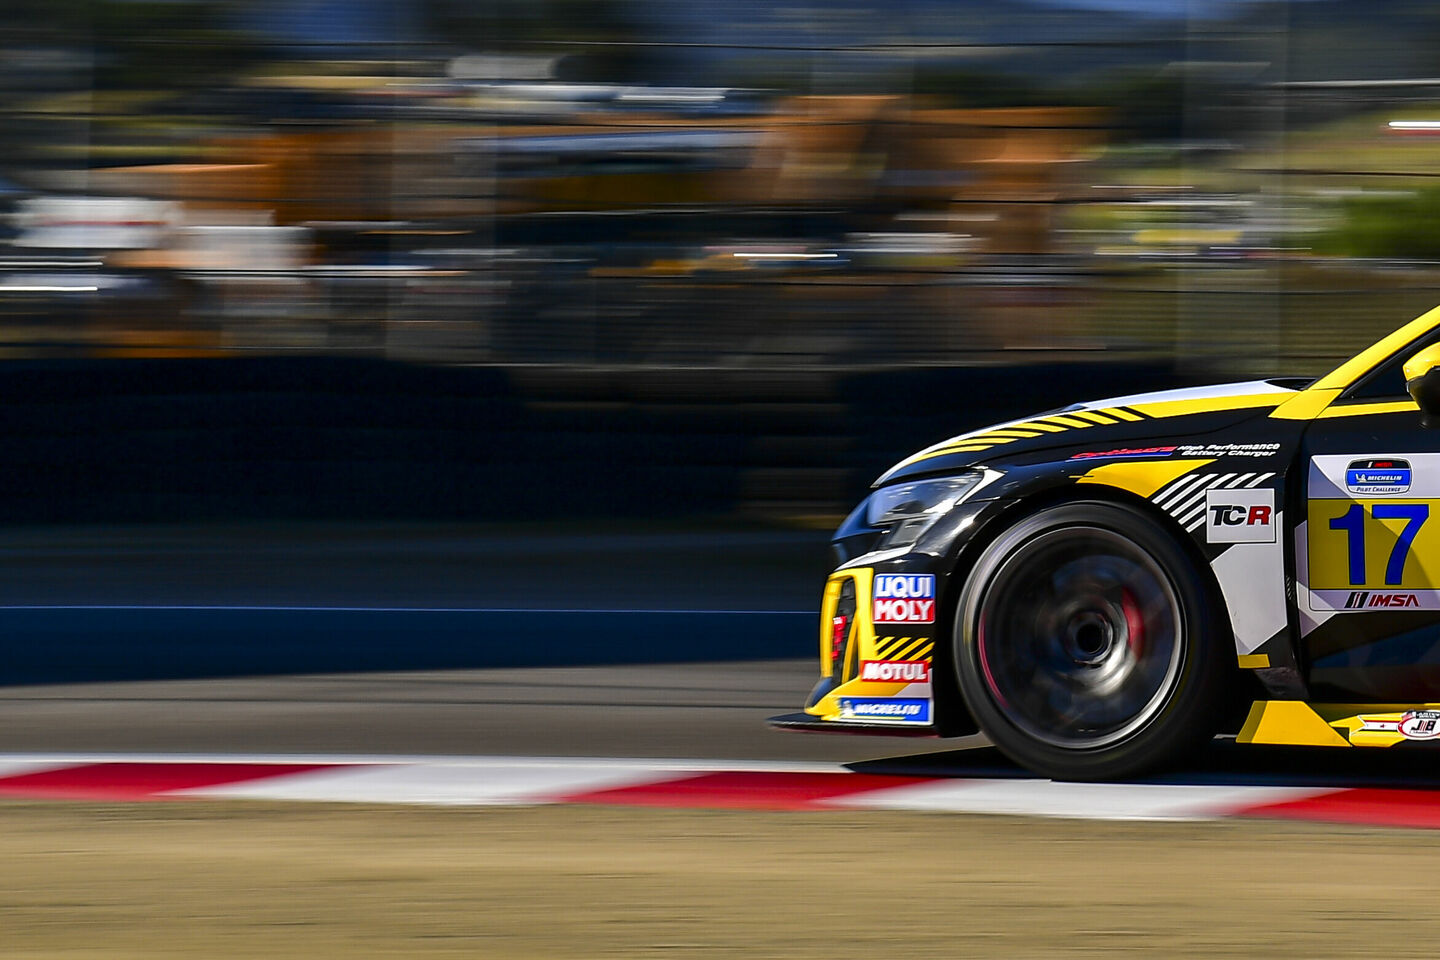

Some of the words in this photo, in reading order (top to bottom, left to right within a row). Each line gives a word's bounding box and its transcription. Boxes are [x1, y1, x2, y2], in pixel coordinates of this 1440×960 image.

[1205, 443, 1281, 451] Performance
[1209, 505, 1272, 527] TCR
[1329, 504, 1430, 586] 17
[874, 576, 932, 599] LIQUI
[874, 600, 934, 622] MOLY
[1368, 594, 1421, 608] IMSA
[861, 663, 928, 681] MOTUL
[852, 703, 922, 715] MICHELIN
